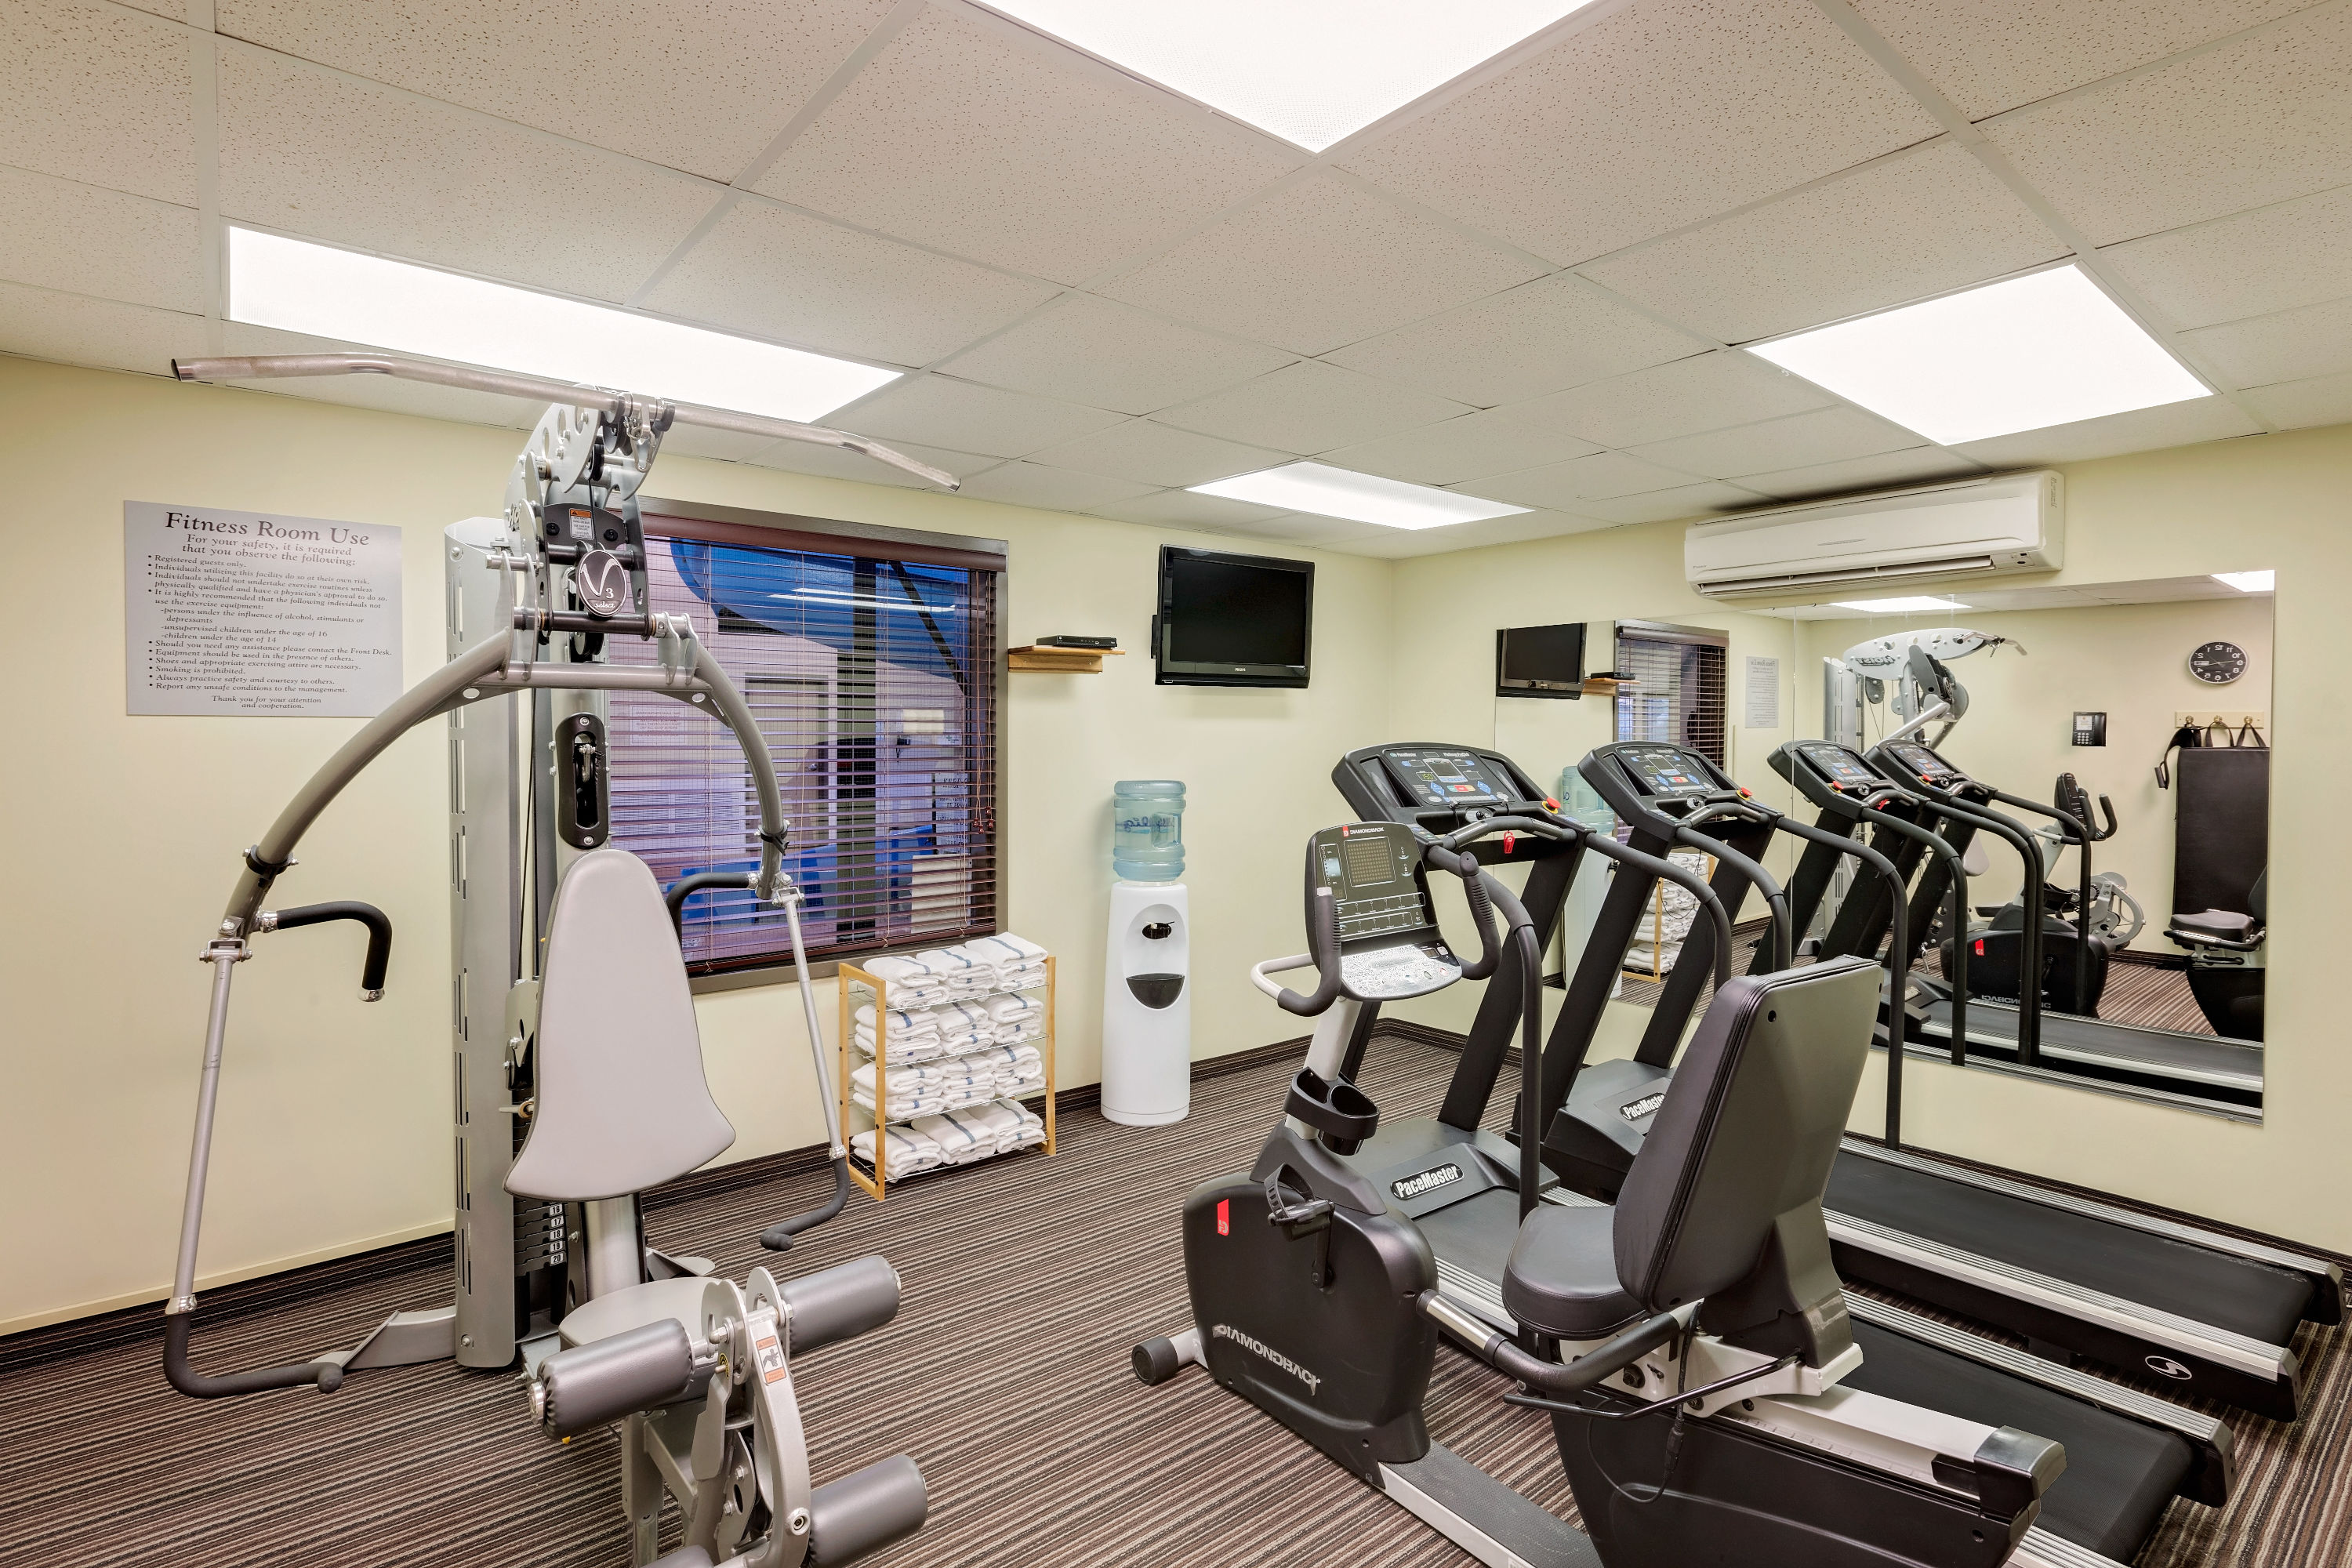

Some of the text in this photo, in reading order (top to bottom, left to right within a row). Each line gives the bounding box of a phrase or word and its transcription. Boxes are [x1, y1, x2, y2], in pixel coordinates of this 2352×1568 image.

[165, 511, 368, 545] Fitness Room Use
[187, 533, 208, 543] For
[241, 539, 278, 550] safety,
[296, 543, 304, 552] is
[308, 547, 351, 556] required
[154, 554, 198, 564] Registered
[183, 543, 355, 566] that you observe the following:
[154, 563, 201, 572] Individuals
[204, 568, 238, 576] utilizing
[256, 571, 283, 579] facility
[154, 572, 202, 582] Individuals
[154, 580, 196, 590] physically
[281, 589, 321, 597] physician's
[605, 588, 614, 599] 3
[174, 590, 199, 599] highly
[290, 597, 325, 606] following
[155, 648, 200, 657] Equipment
[1396, 1166, 1458, 1198] PaceMaster
